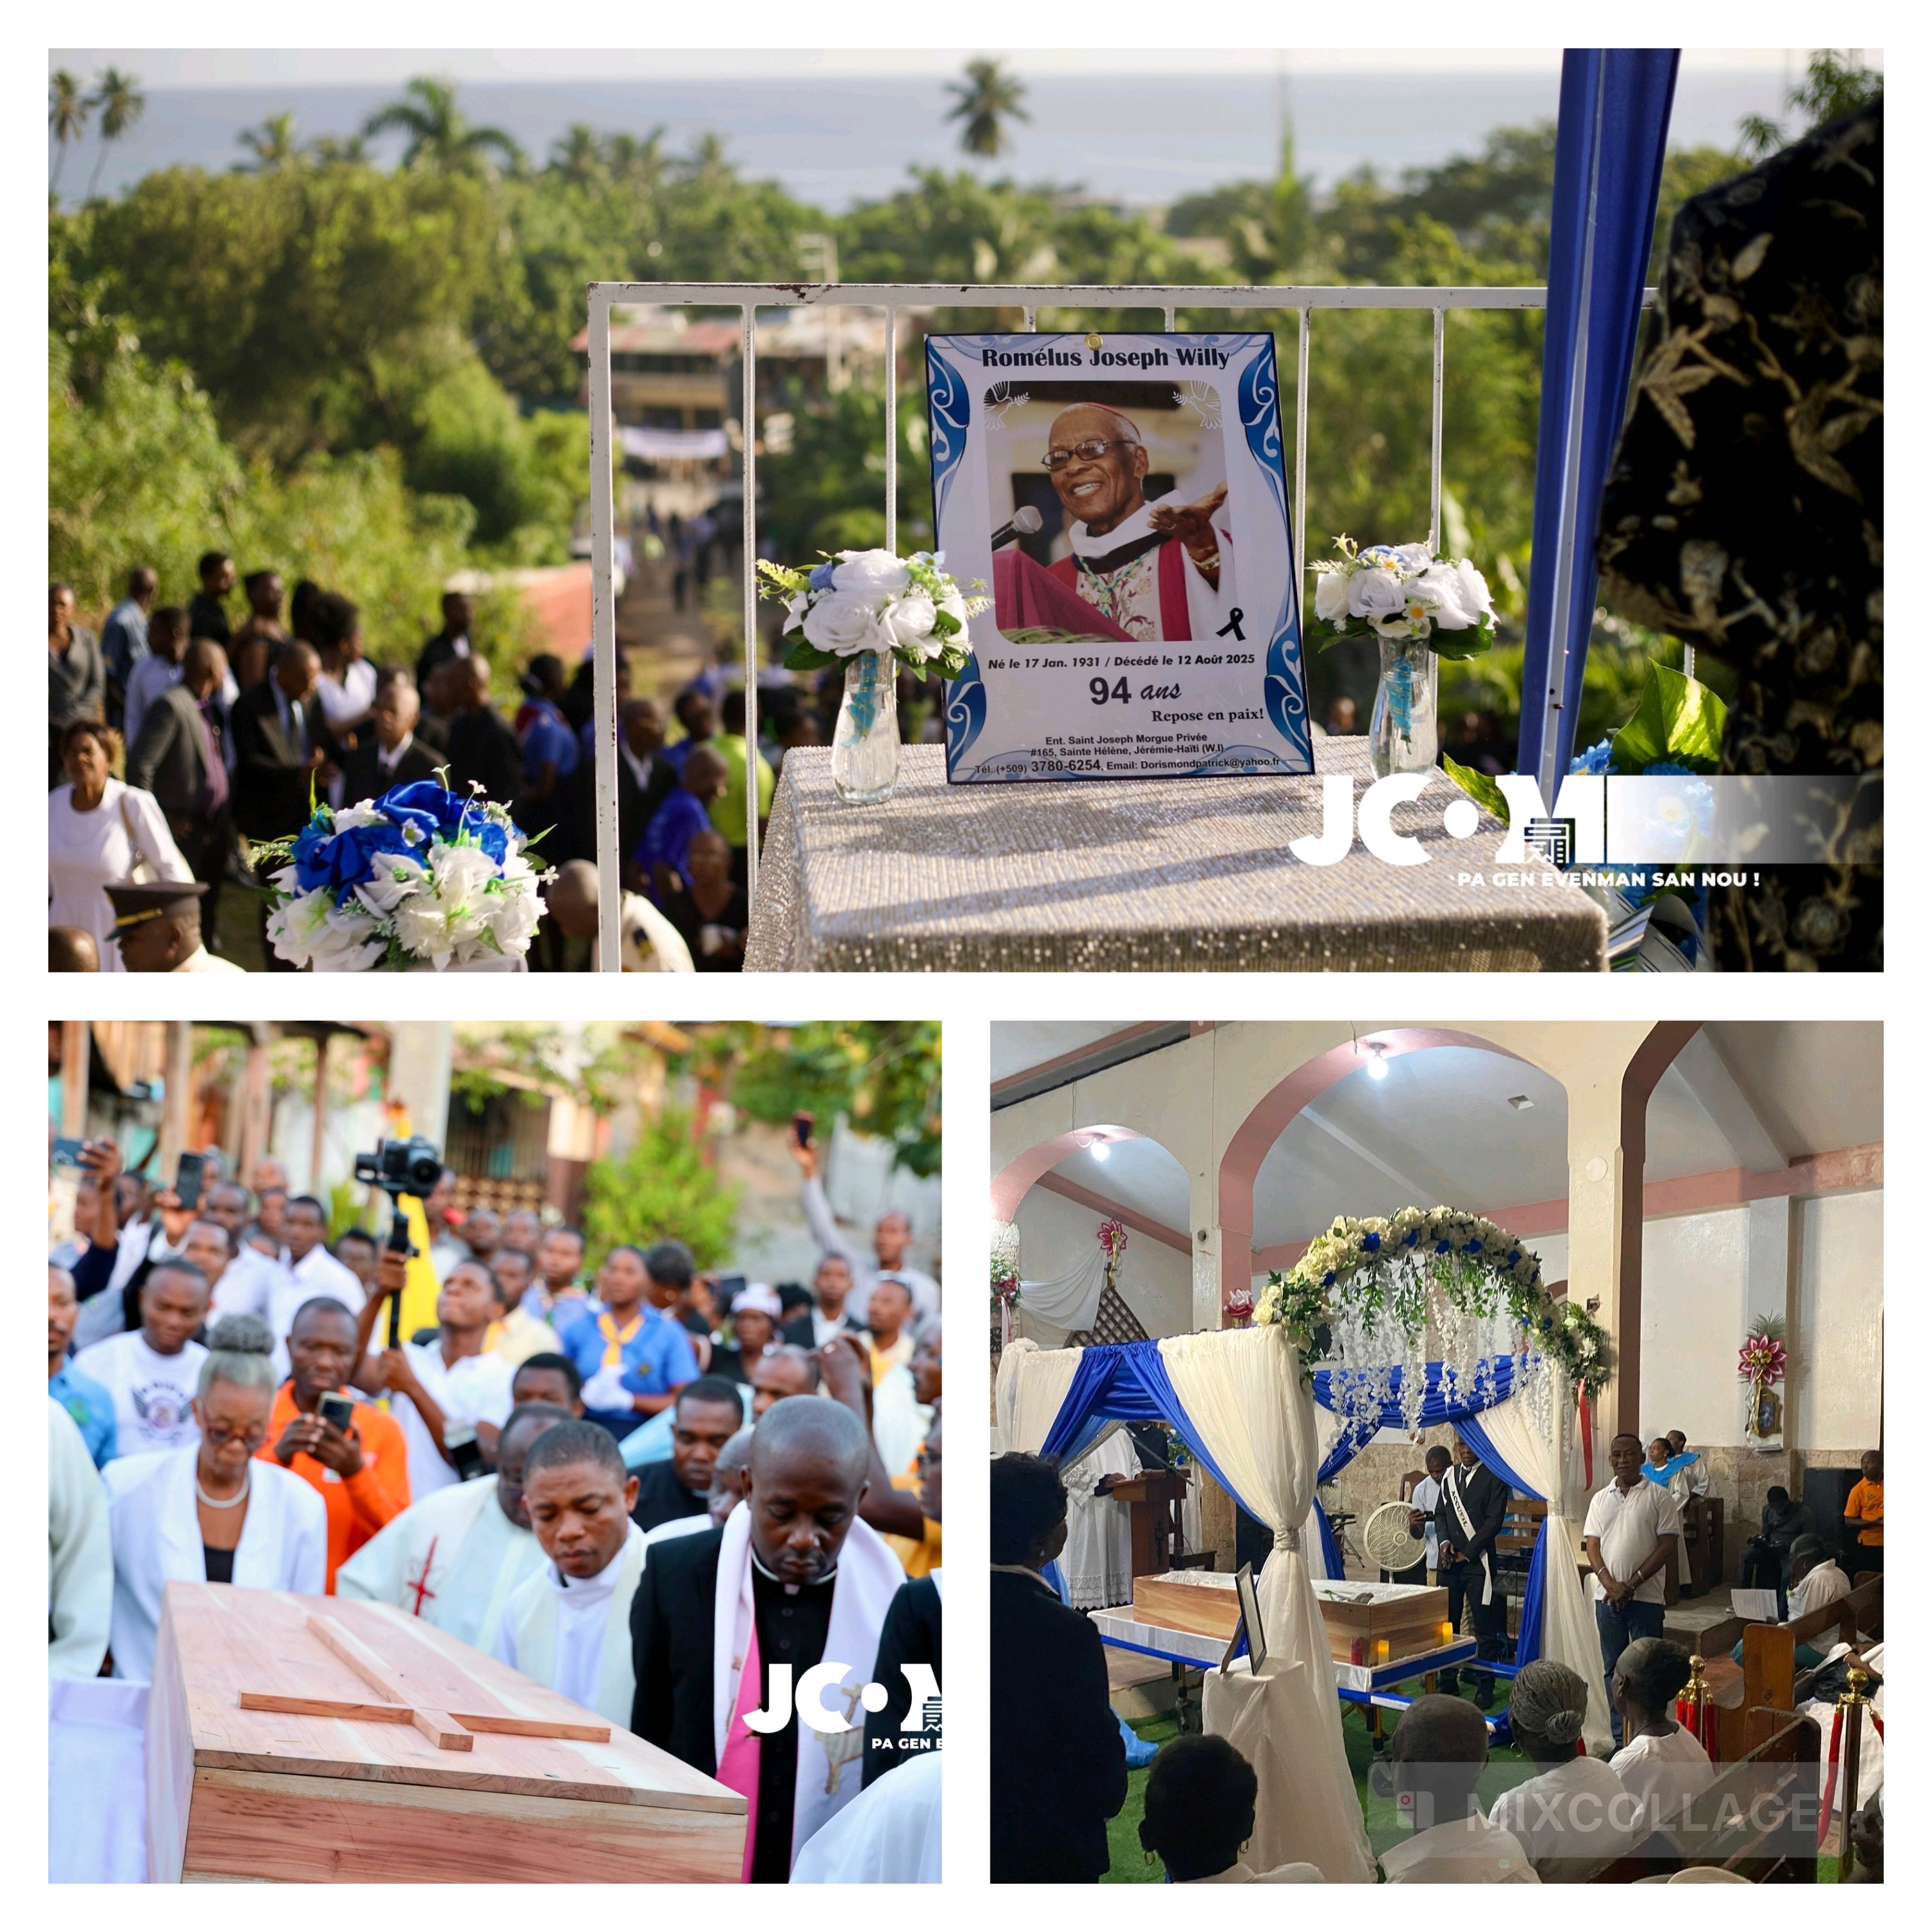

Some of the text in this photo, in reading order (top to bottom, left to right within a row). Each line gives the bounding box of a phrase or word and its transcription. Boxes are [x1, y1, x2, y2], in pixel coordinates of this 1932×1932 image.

[982, 347, 1230, 370] Romélus Joseph Willy
[988, 654, 1255, 669] Né le 17 Jan. 1931 / Décédé le 12 Août 2025
[1089, 676, 1182, 705] 94 ans
[1151, 708, 1264, 724] Repose en paix!
[1046, 733, 1208, 745] Ent. Saint Joseph Morgue Privée
[1030, 744, 1224, 757] #165, Sainte Hélène, Jérémie-Haïti (W.I)
[975, 757, 1280, 775] Tél. (+509) 3780-6254, Email: Dorismondpatrick@yahoo.fr
[1451, 1490, 1468, 1528] ACCUEIL
